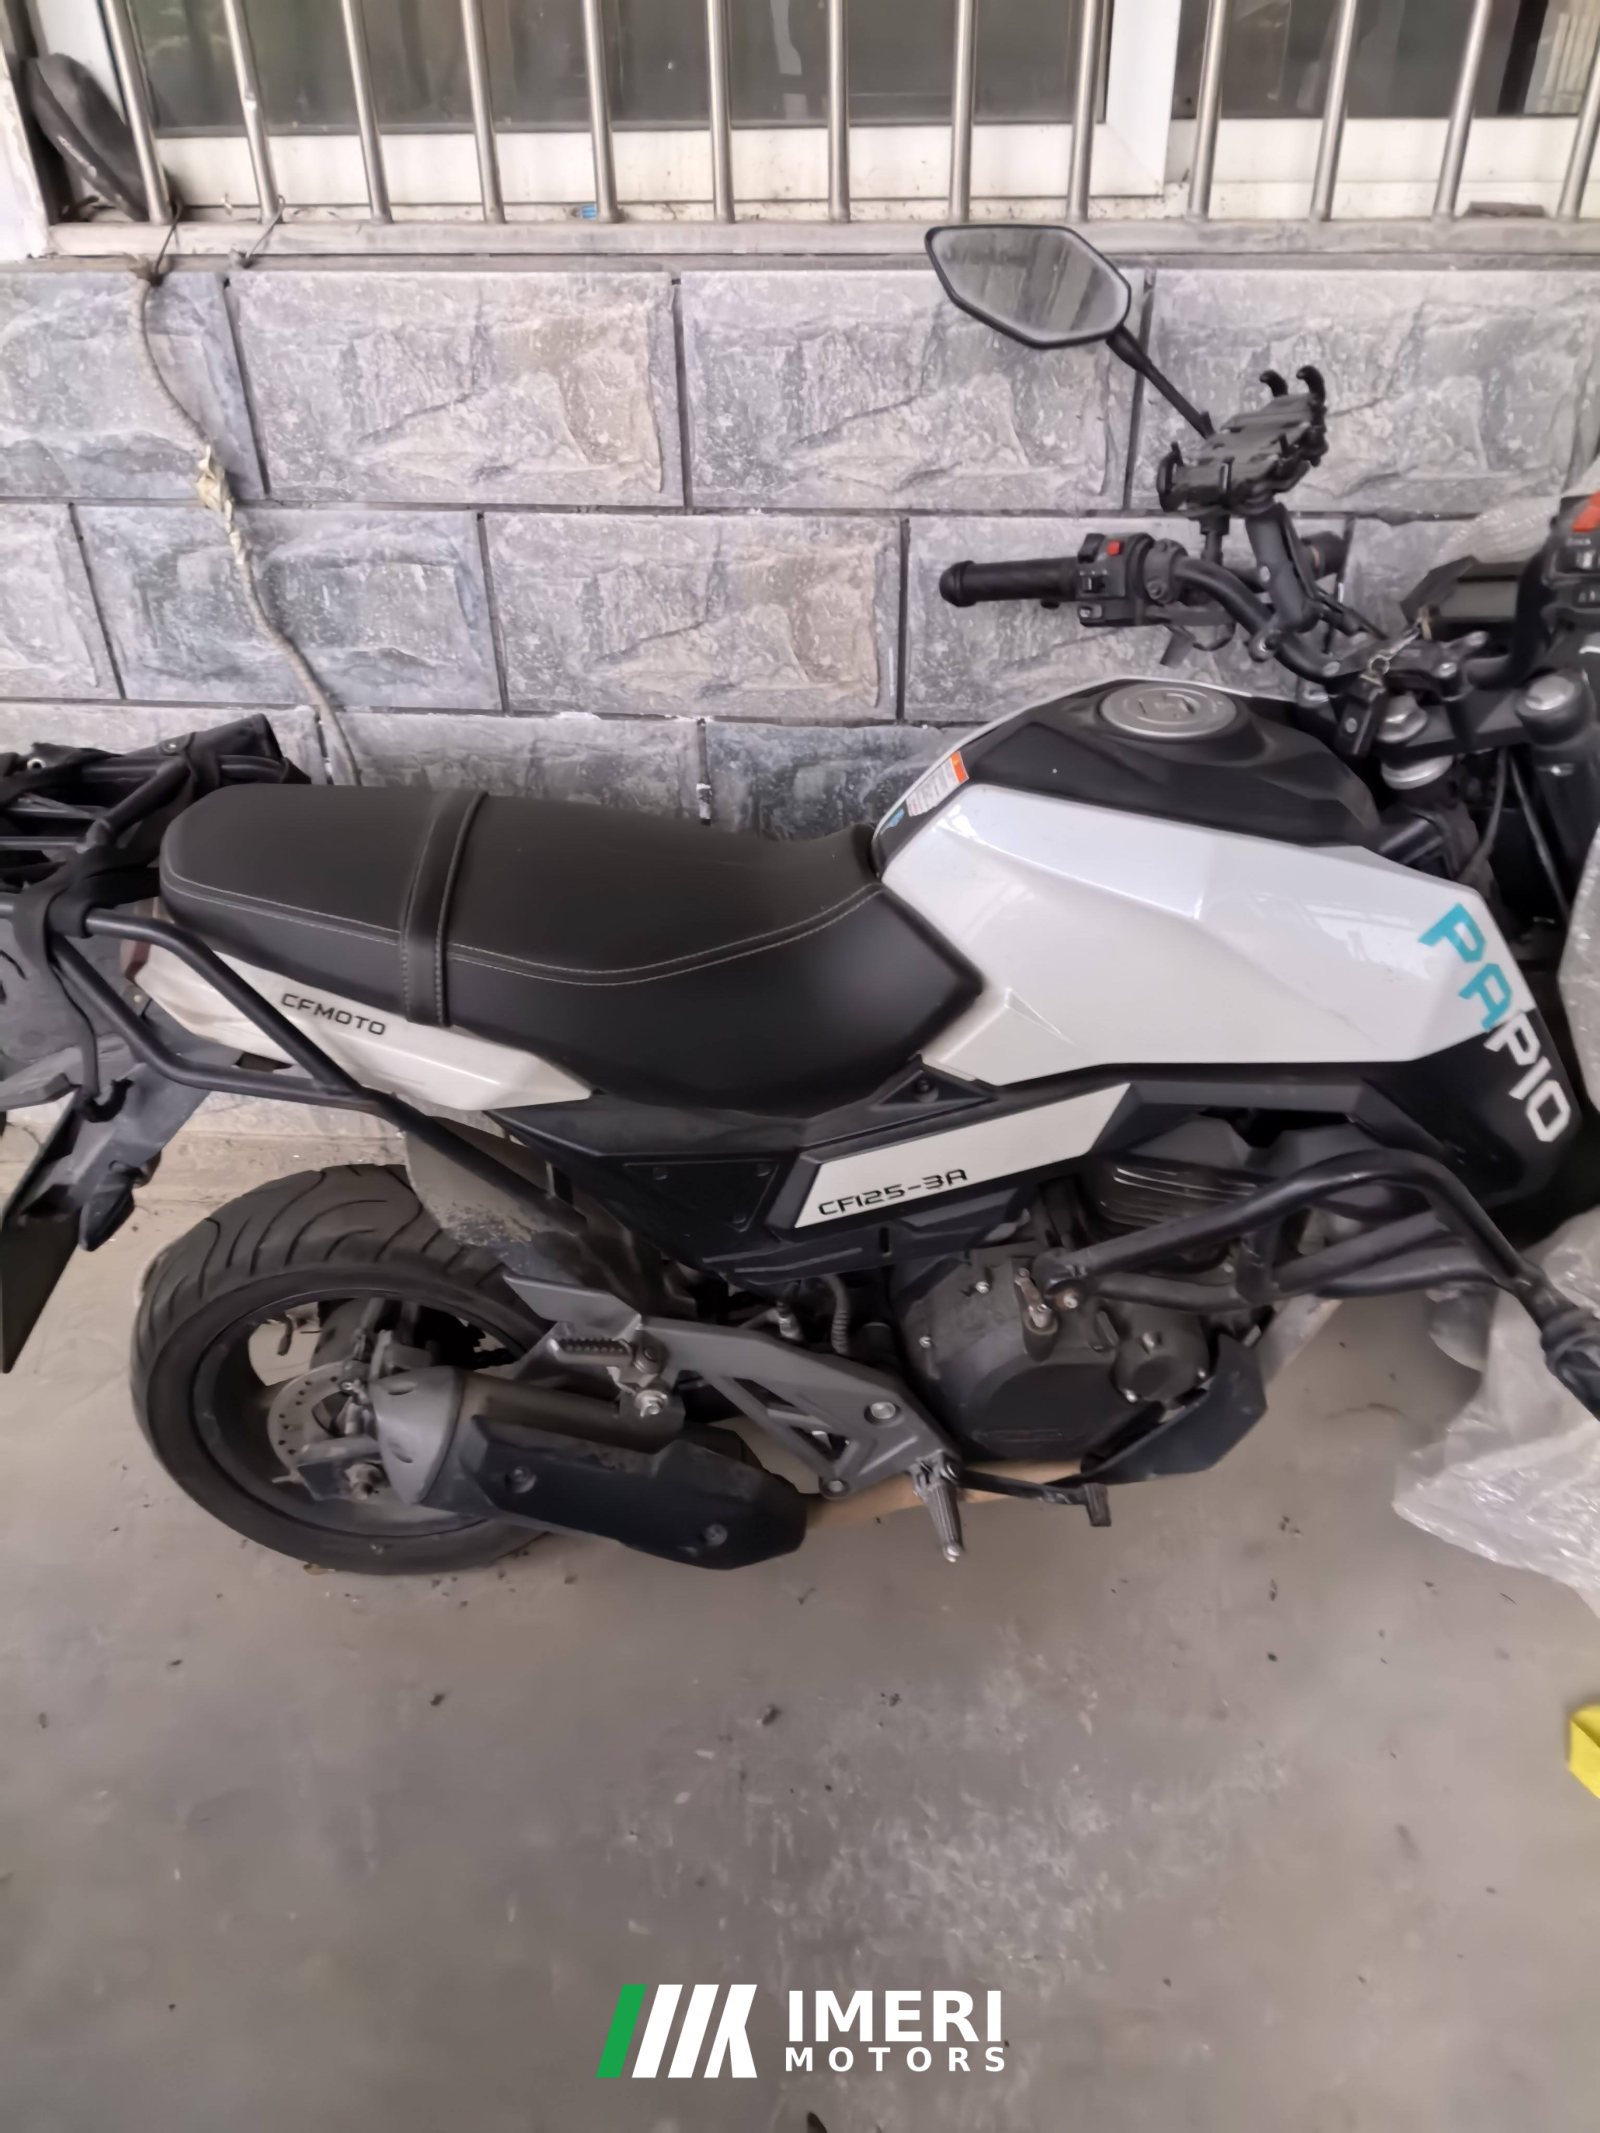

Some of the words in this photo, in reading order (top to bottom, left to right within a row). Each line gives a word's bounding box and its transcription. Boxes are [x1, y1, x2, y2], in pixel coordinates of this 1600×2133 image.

[281, 993, 386, 1035] CFMOTO
[1418, 903, 1571, 1142] PAPIO
[818, 1169, 968, 1215] CF125-3A
